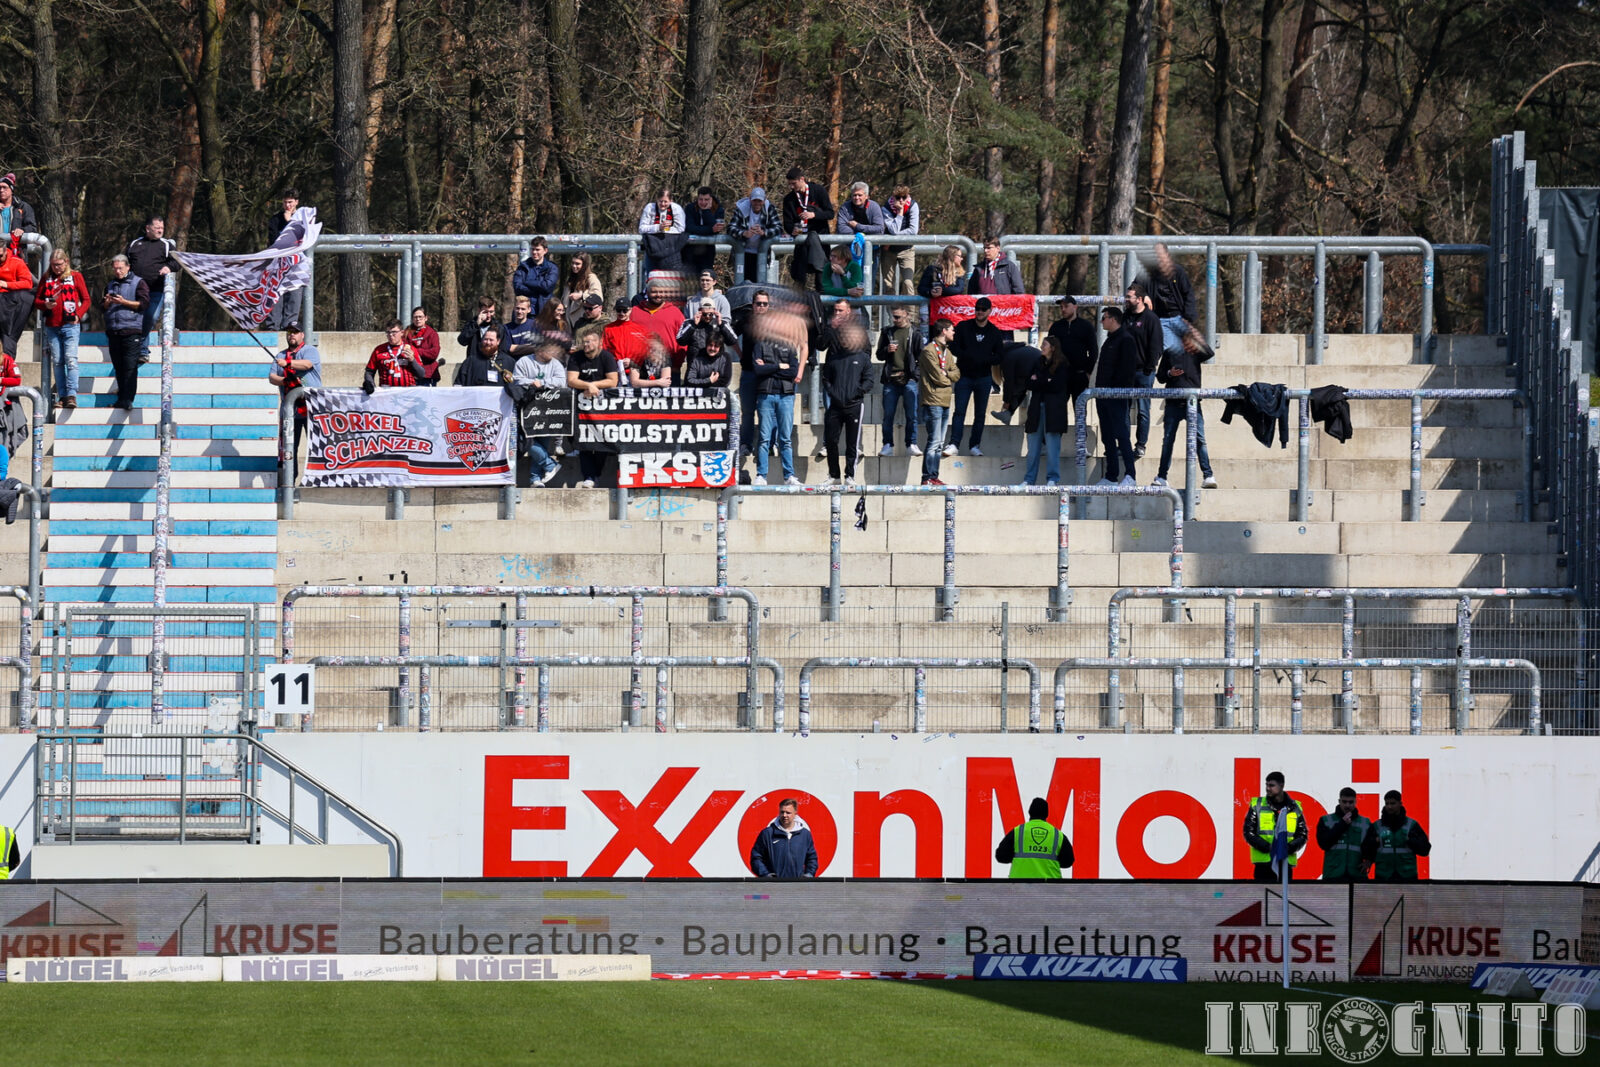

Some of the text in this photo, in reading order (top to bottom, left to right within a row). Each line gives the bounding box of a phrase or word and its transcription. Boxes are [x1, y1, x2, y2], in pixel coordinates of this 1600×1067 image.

[313, 413, 404, 435] TORKEL
[578, 423, 727, 444] INGOLSTADT
[443, 433, 484, 444] TORKEL
[324, 436, 432, 468] SCHANZER
[618, 452, 697, 486] FKS
[270, 672, 309, 705] 11
[483, 755, 1430, 879] ExxonMobil
[1028, 845, 1048, 853] 1023
[1, 934, 125, 959] KRUSE
[213, 924, 338, 954] KRUSE
[379, 924, 1183, 962] Bauberatung Bauplanung Bauleitung
[1213, 934, 1336, 964] KRUSE
[1406, 925, 1501, 958] KRUSE
[25, 957, 128, 982] NÖGEL
[241, 957, 344, 981] NÖGEL
[455, 956, 558, 980] NÖGEL
[1029, 956, 1132, 978] KUZKA
